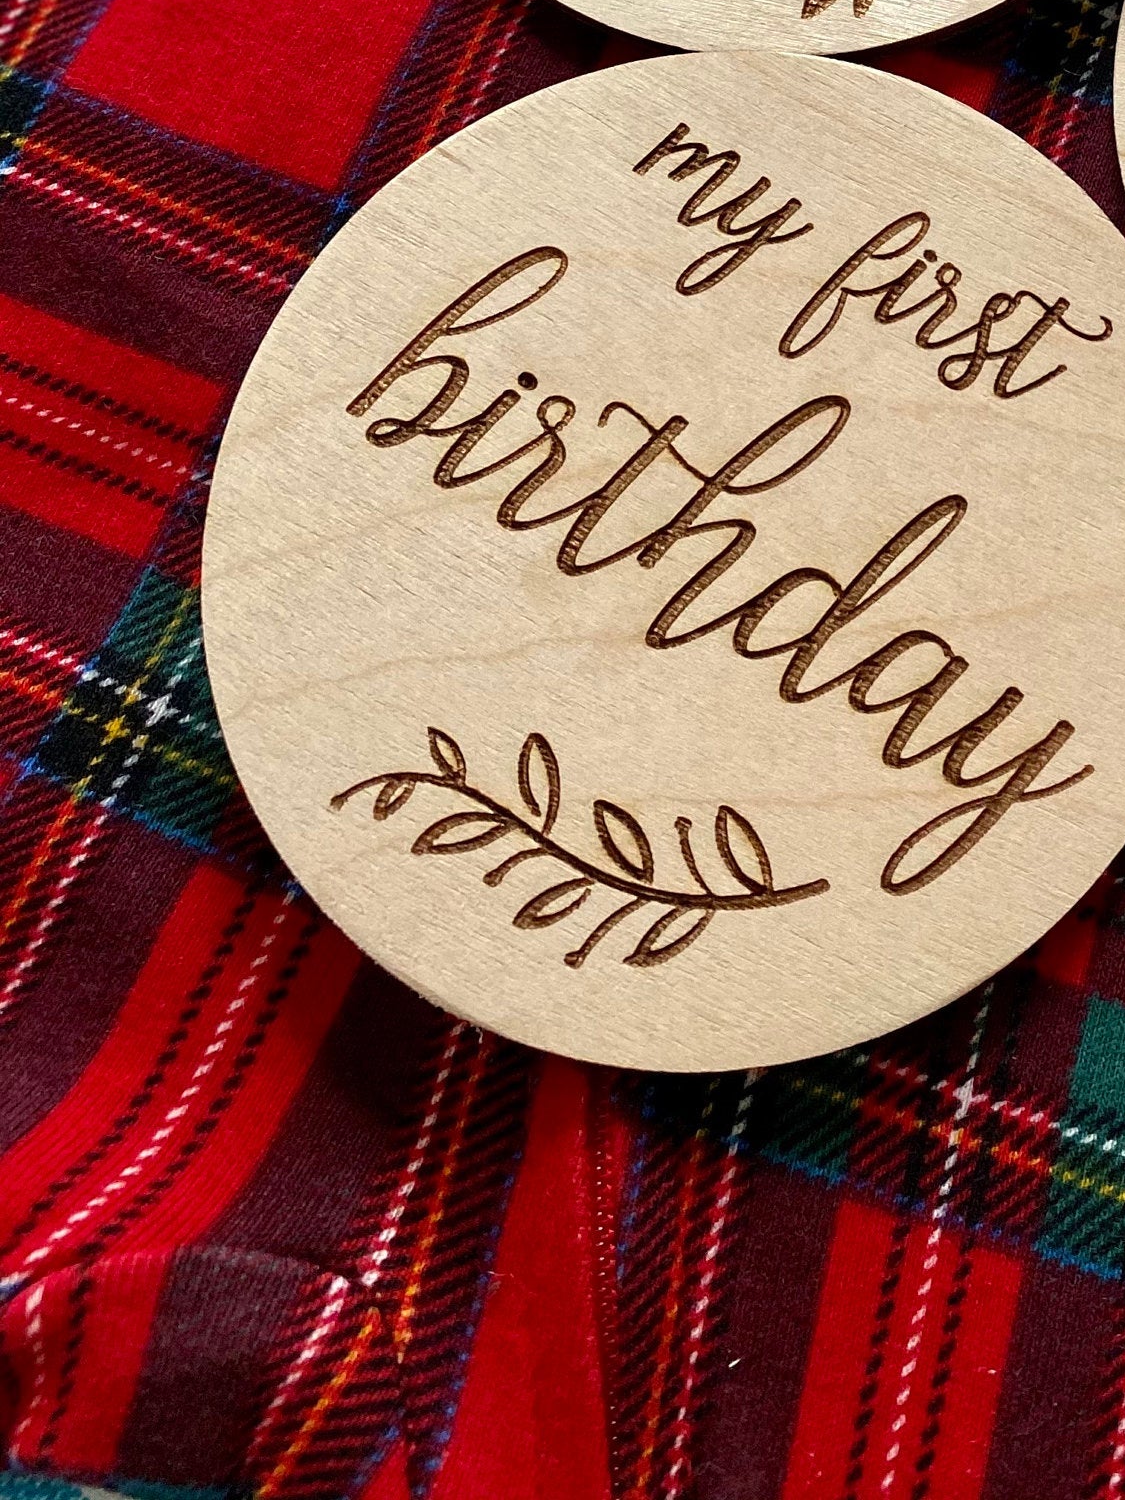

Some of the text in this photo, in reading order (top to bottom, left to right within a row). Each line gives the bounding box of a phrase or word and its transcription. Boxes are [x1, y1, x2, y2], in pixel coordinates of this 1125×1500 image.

[632, 122, 1114, 400] my first
[346, 245, 1096, 897] birthday
